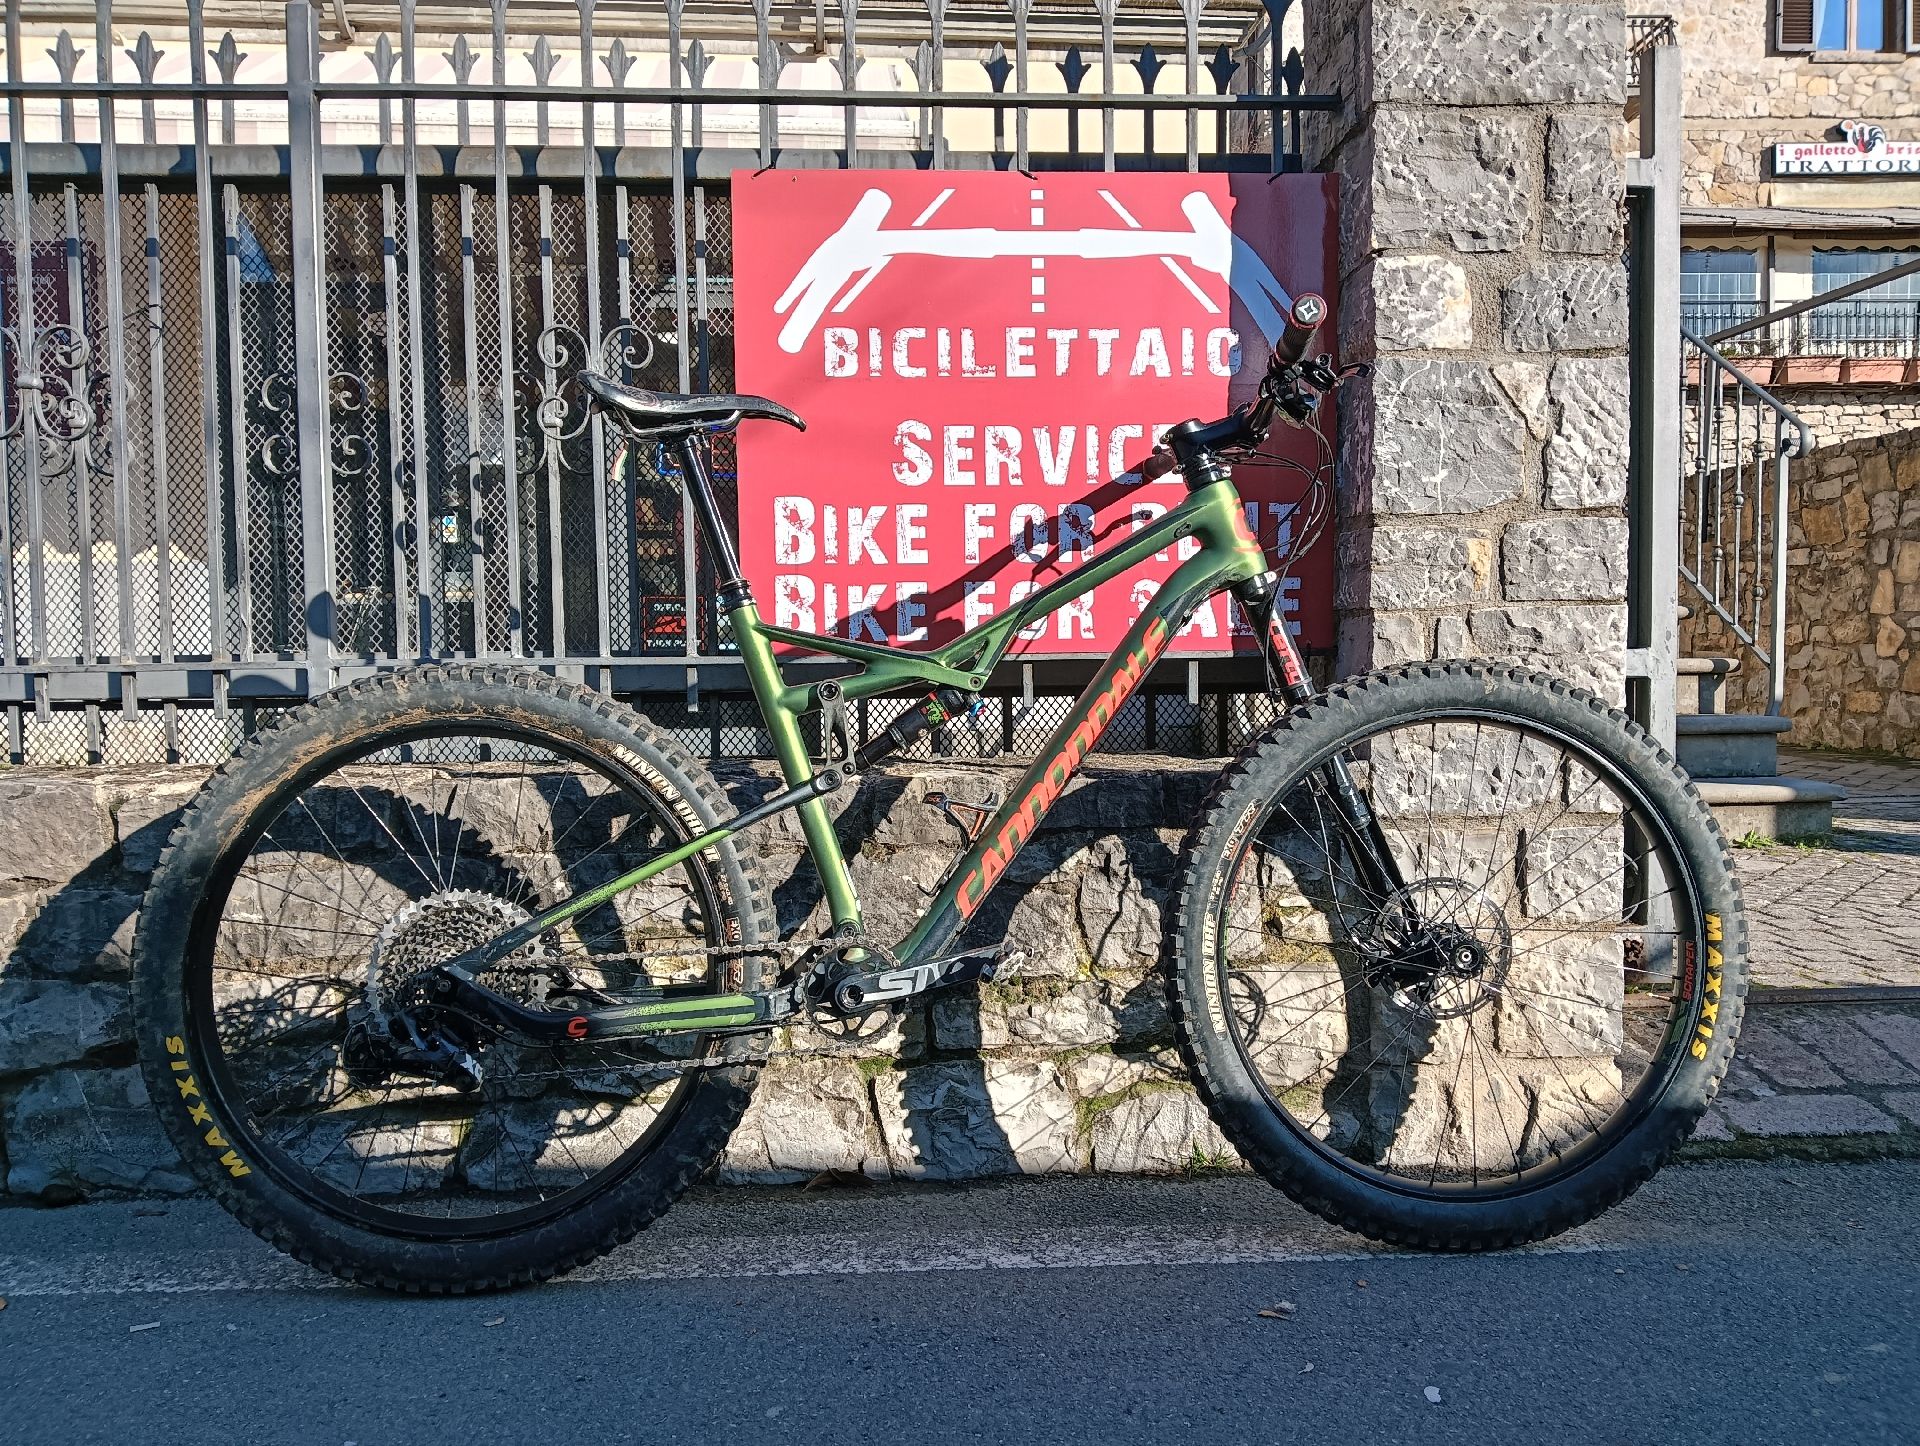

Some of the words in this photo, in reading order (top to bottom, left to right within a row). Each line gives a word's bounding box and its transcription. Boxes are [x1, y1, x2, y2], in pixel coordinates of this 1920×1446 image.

[1794, 144, 1857, 160] galletto
[823, 326, 1242, 378] BICILETTAIO
[774, 496, 929, 565] BIKE
[964, 503, 1096, 563] FOR
[774, 574, 929, 642] BIKE
[964, 581, 1096, 640] FOR
[611, 744, 681, 801] MINION
[1203, 959, 1227, 1034] MINION
[1683, 940, 1695, 1001] SCRAPER
[1691, 911, 1723, 1061] MAXXIS
[165, 1036, 251, 1178] MAXXIS
